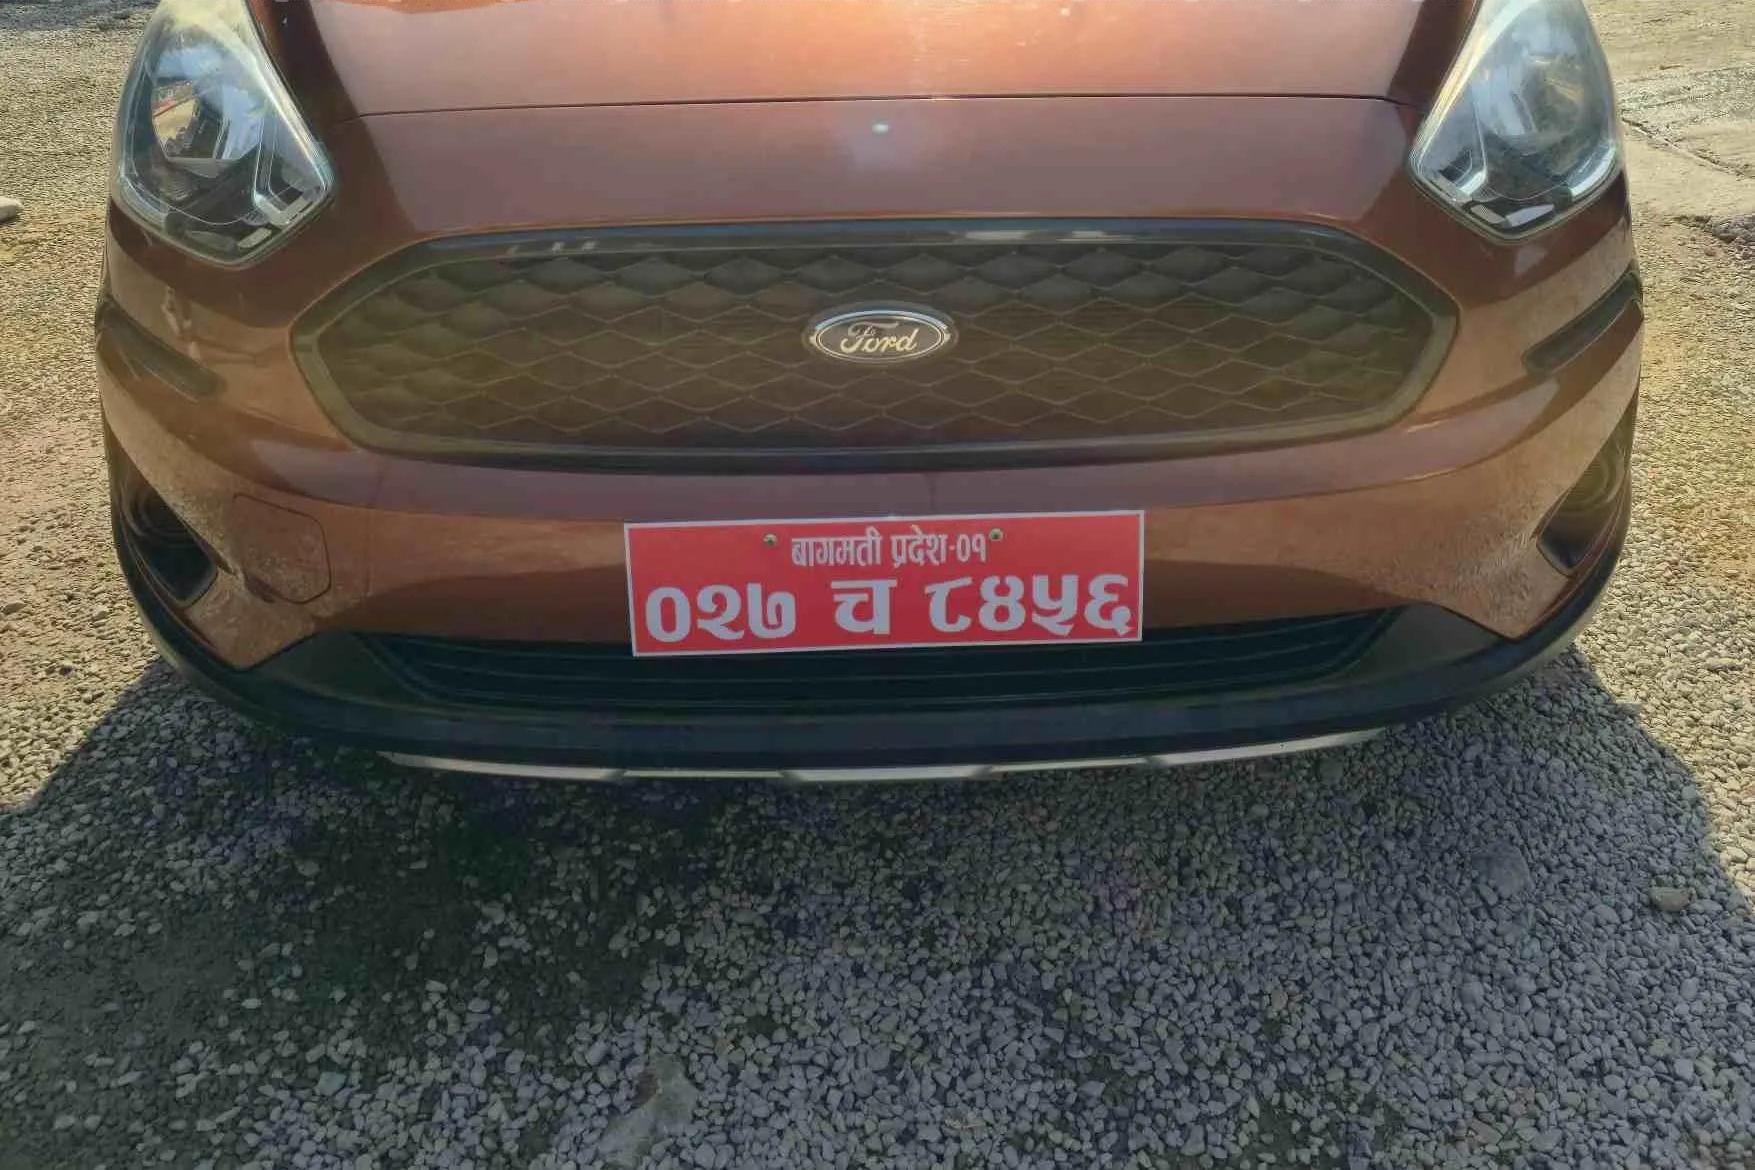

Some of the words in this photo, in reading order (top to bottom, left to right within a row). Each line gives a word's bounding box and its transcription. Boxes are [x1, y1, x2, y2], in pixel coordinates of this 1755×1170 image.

[840, 321, 919, 354] Ford
[791, 527, 880, 567] बागमती
[890, 524, 987, 567] प्रदेश-०१
[645, 584, 797, 642] ०२७
[831, 578, 898, 636] च
[924, 573, 1134, 637] ८४५६
